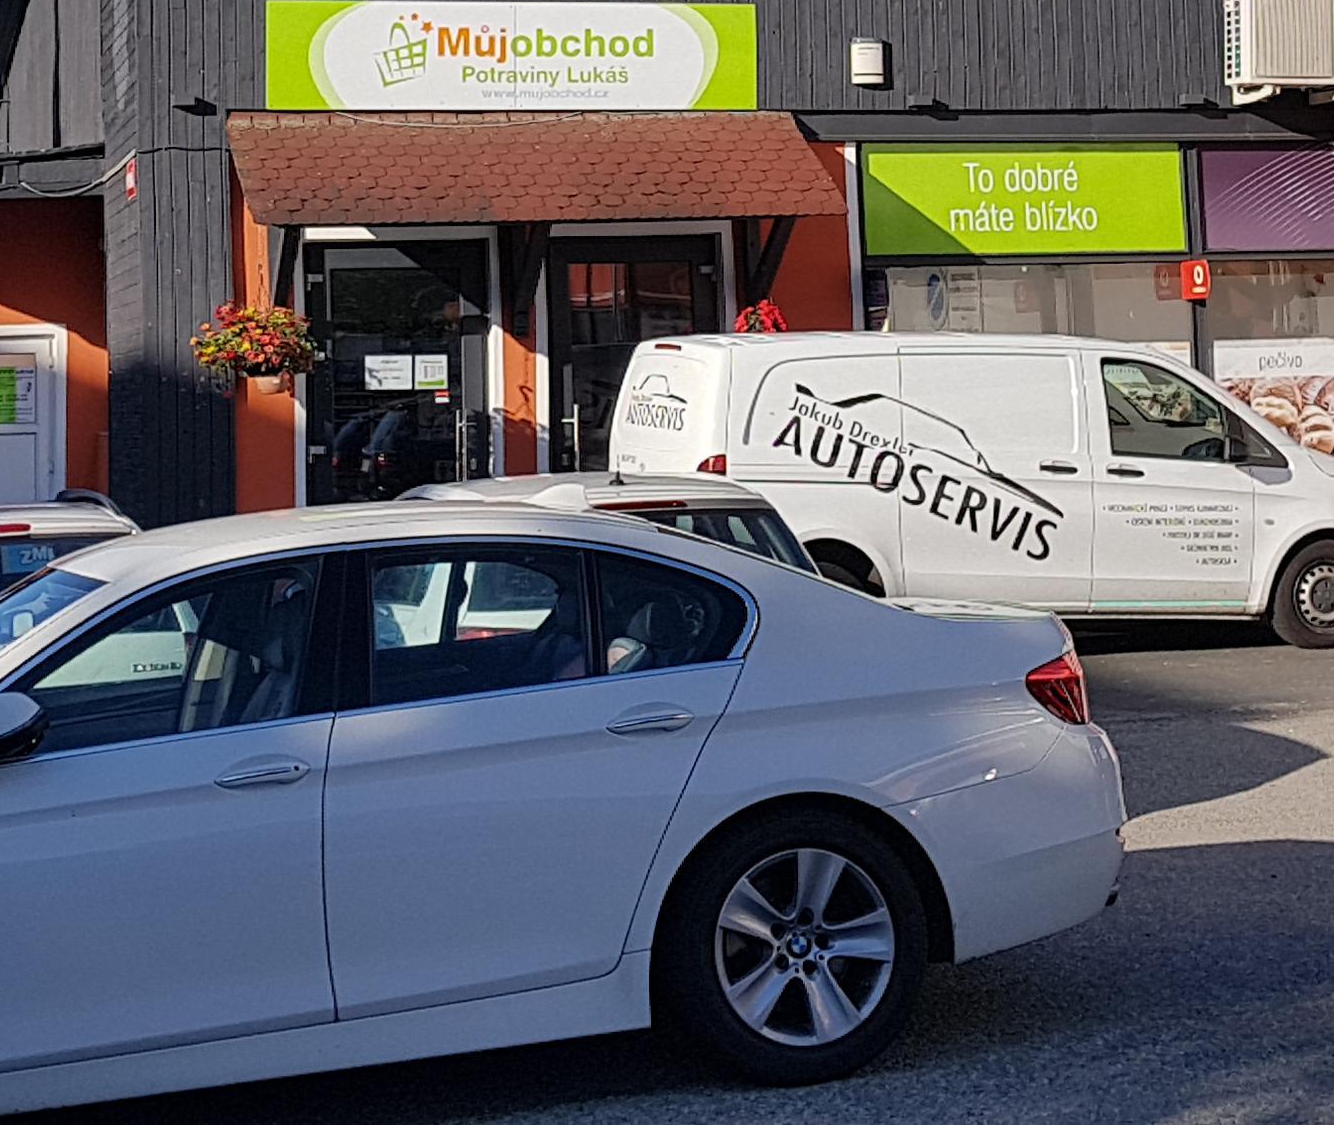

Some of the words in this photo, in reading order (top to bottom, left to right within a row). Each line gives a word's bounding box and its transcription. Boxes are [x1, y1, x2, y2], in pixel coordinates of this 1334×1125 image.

[437, 25, 654, 63] Můjobchod
[462, 66, 560, 87] Potraviny
[568, 66, 629, 83] Lukáš
[962, 162, 994, 193] To
[1005, 160, 1078, 193] dobré
[950, 200, 1014, 232] máte
[1024, 200, 1098, 232] blízko
[1259, 352, 1303, 372] pečivo
[789, 396, 844, 430] Jakub
[772, 416, 1059, 561] AUTOSERVIS
